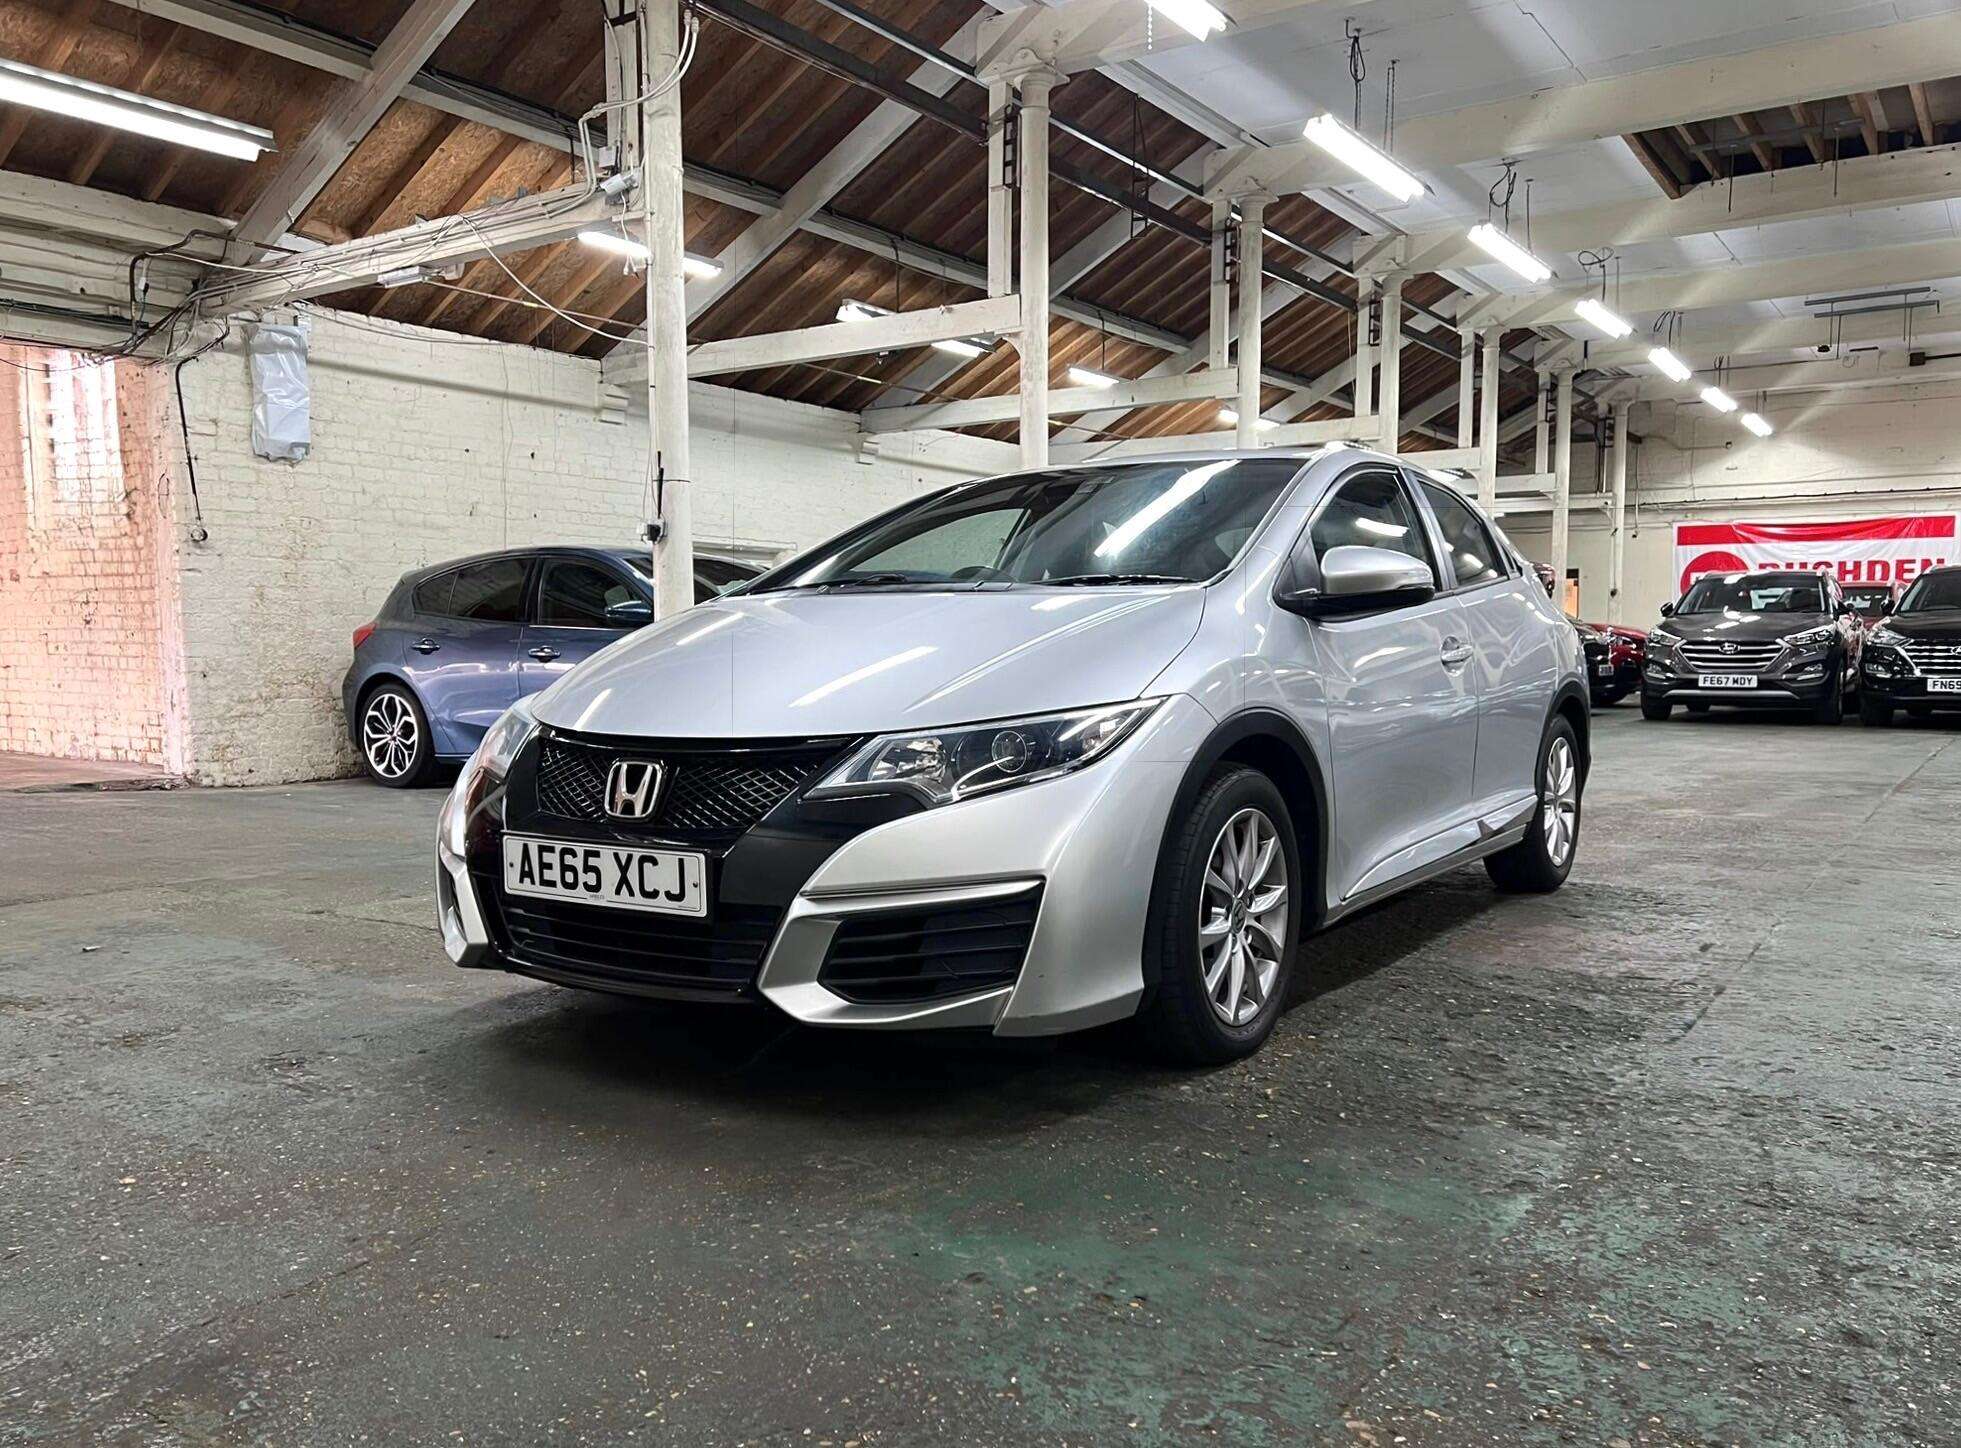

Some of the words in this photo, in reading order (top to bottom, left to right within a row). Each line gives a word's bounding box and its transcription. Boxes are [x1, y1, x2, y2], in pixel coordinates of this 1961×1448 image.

[1703, 676, 1730, 685] FE67
[518, 843, 602, 893] AE65
[612, 851, 686, 902] XCJ
